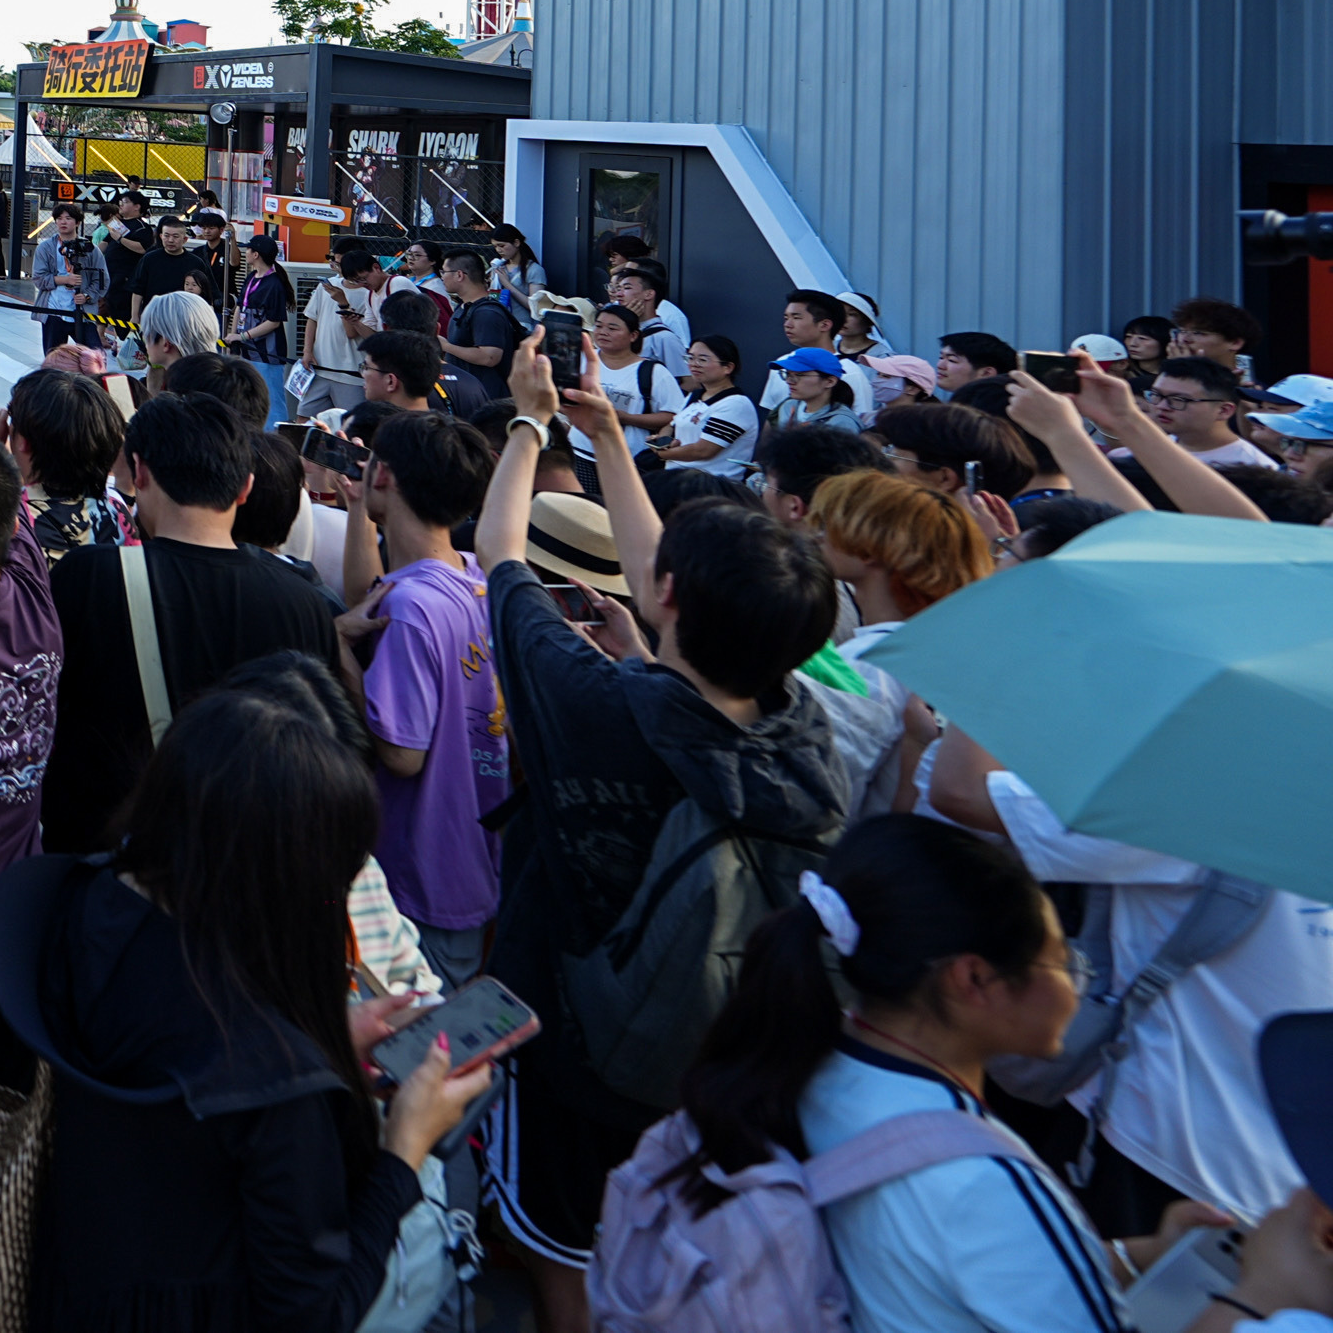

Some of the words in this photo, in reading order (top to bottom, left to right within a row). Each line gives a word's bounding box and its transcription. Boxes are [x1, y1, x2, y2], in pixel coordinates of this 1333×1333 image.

[46, 43, 146, 94] 骑行委托站
[231, 76, 274, 89] ZENLESS
[347, 129, 401, 161] SHARK
[418, 131, 480, 160] LYCAON
